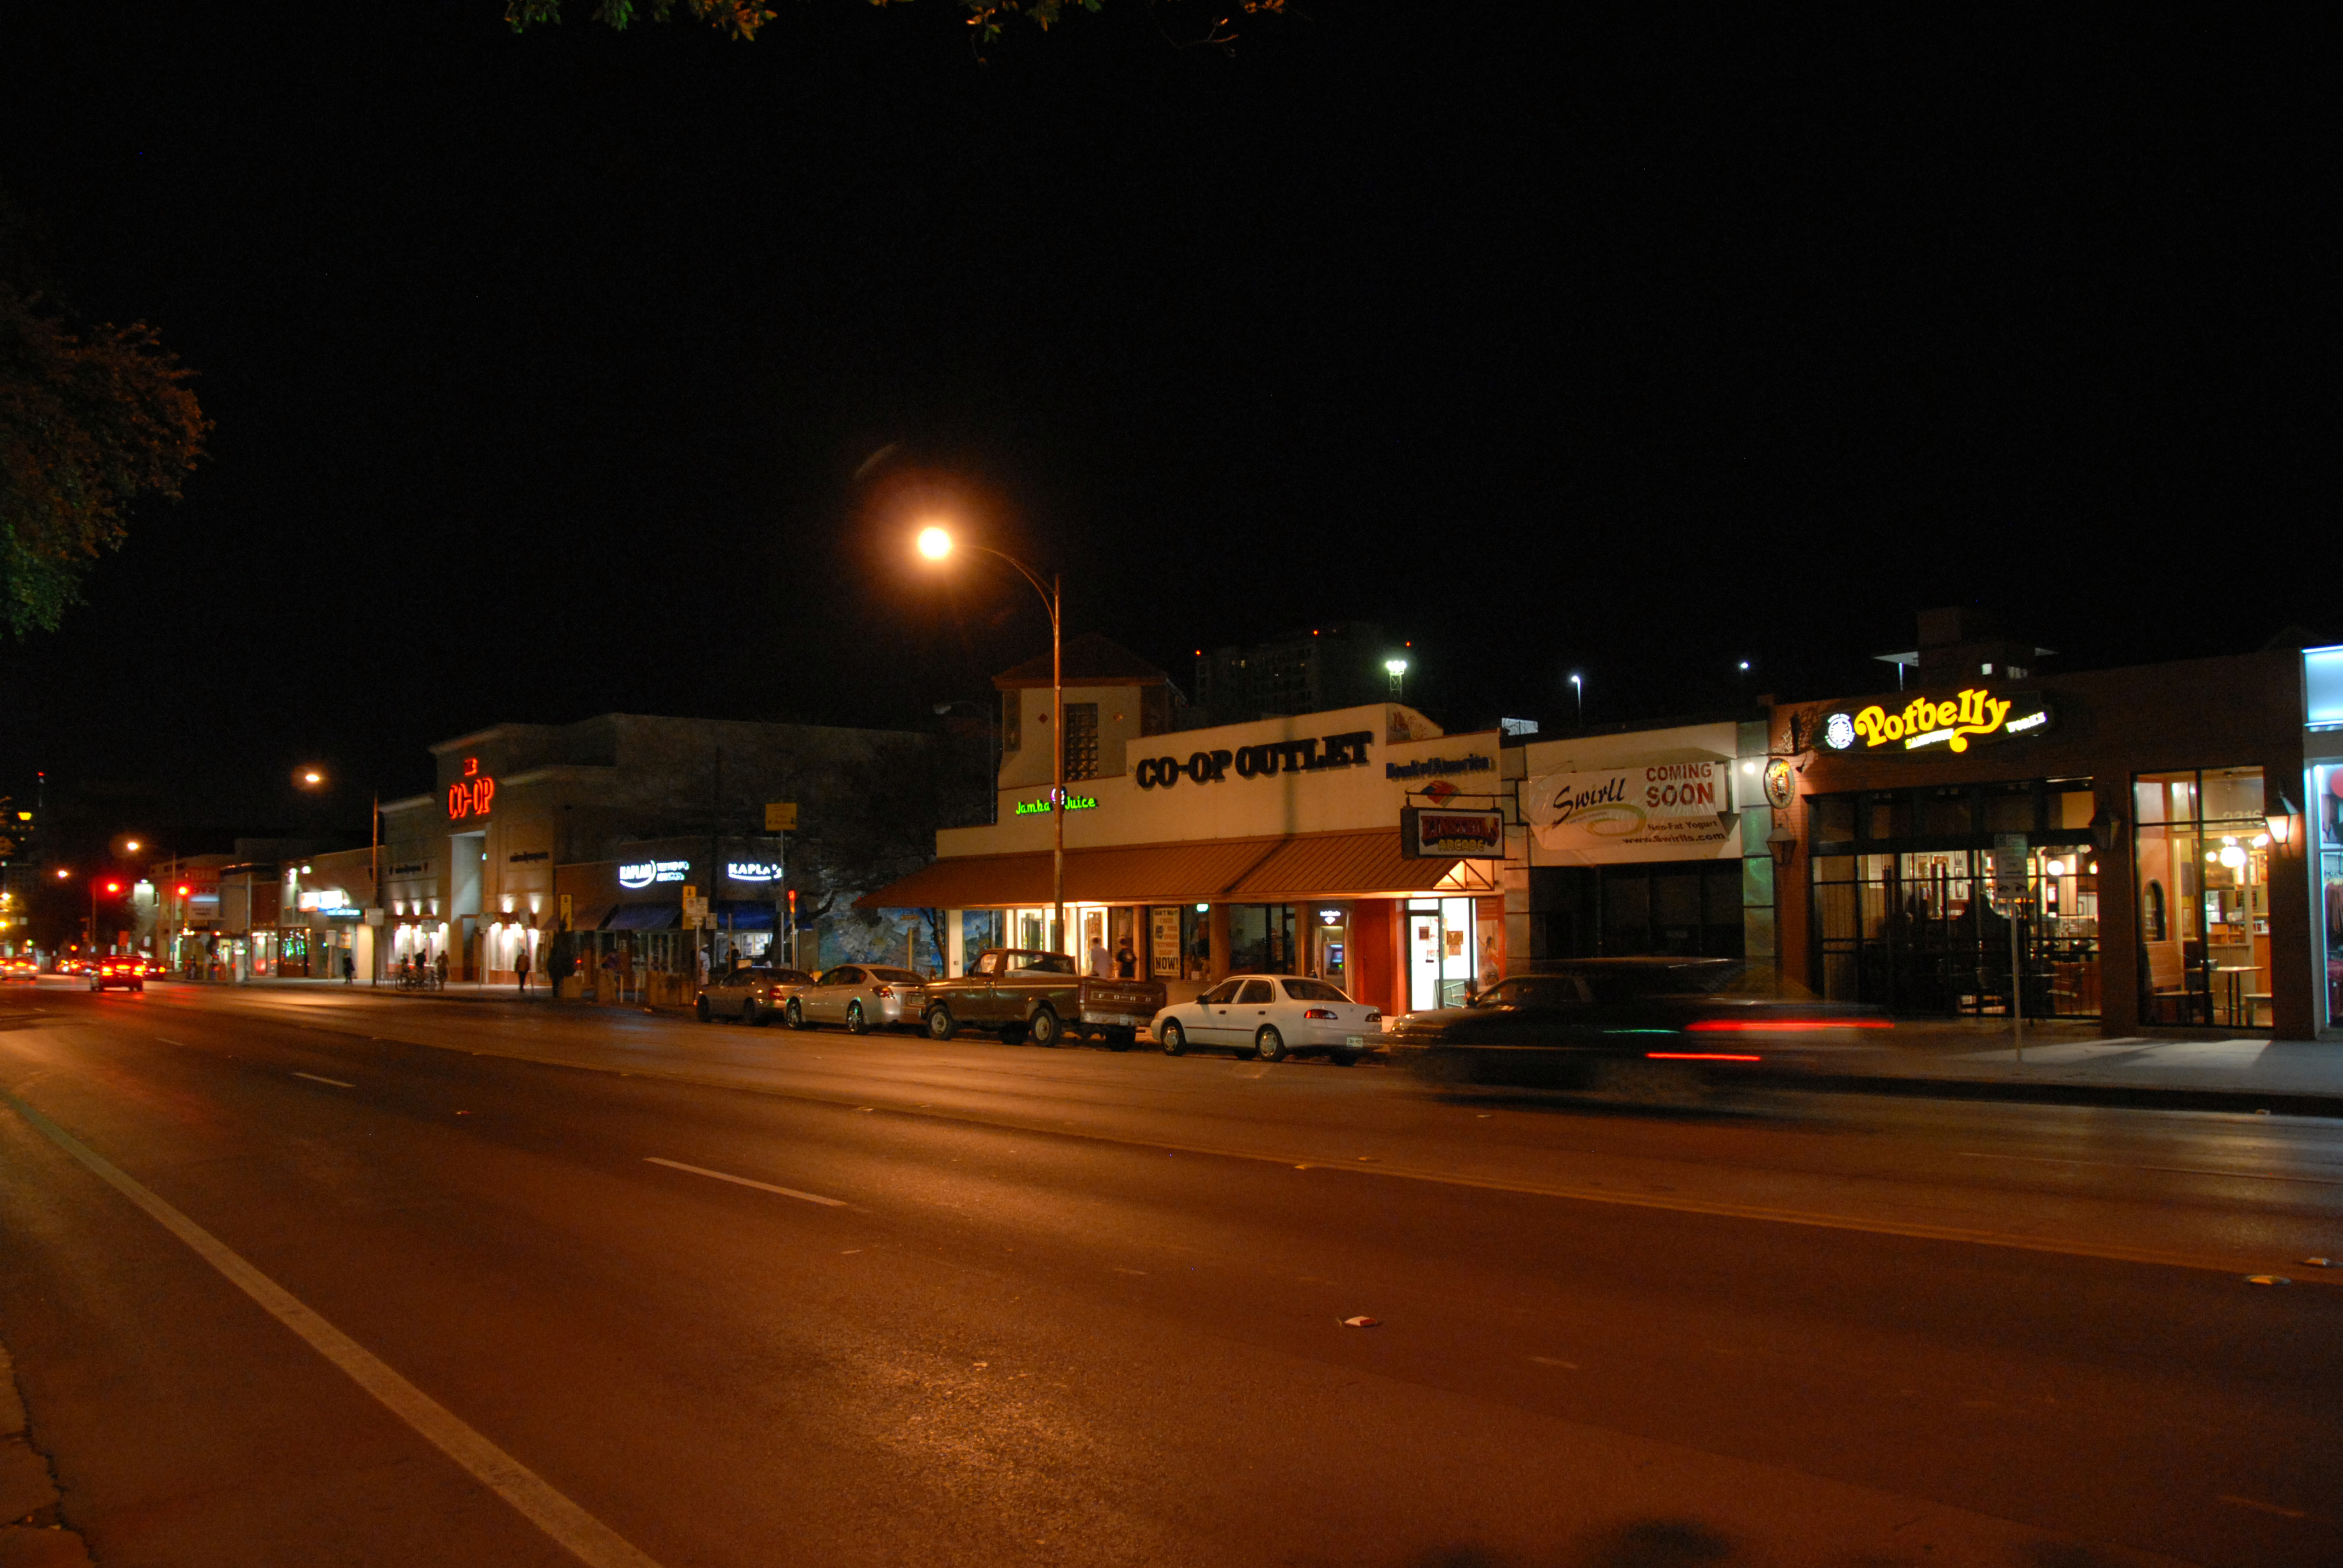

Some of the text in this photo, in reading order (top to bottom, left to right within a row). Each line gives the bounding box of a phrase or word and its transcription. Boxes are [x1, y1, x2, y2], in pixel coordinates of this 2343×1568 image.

[1854, 689, 2011, 752] Potbelly
[2006, 712, 2046, 733] WORKS
[1136, 730, 1374, 789] CO-OP OUTLET
[1386, 754, 1489, 779] Bank of America
[1647, 763, 1712, 782] COMING
[449, 777, 495, 819] CO-OP
[1015, 795, 1096, 815] Jamba Juice
[1553, 777, 1626, 829] Swirll
[1647, 782, 1714, 808] SOON
[1648, 820, 1718, 831] Non-Fat Yogurt
[1438, 838, 1484, 852] ARCADE
[1623, 832, 1725, 844] www.Swirlls.com
[1155, 956, 1179, 970] NOW!
[1098, 993, 1152, 1002] FORD
